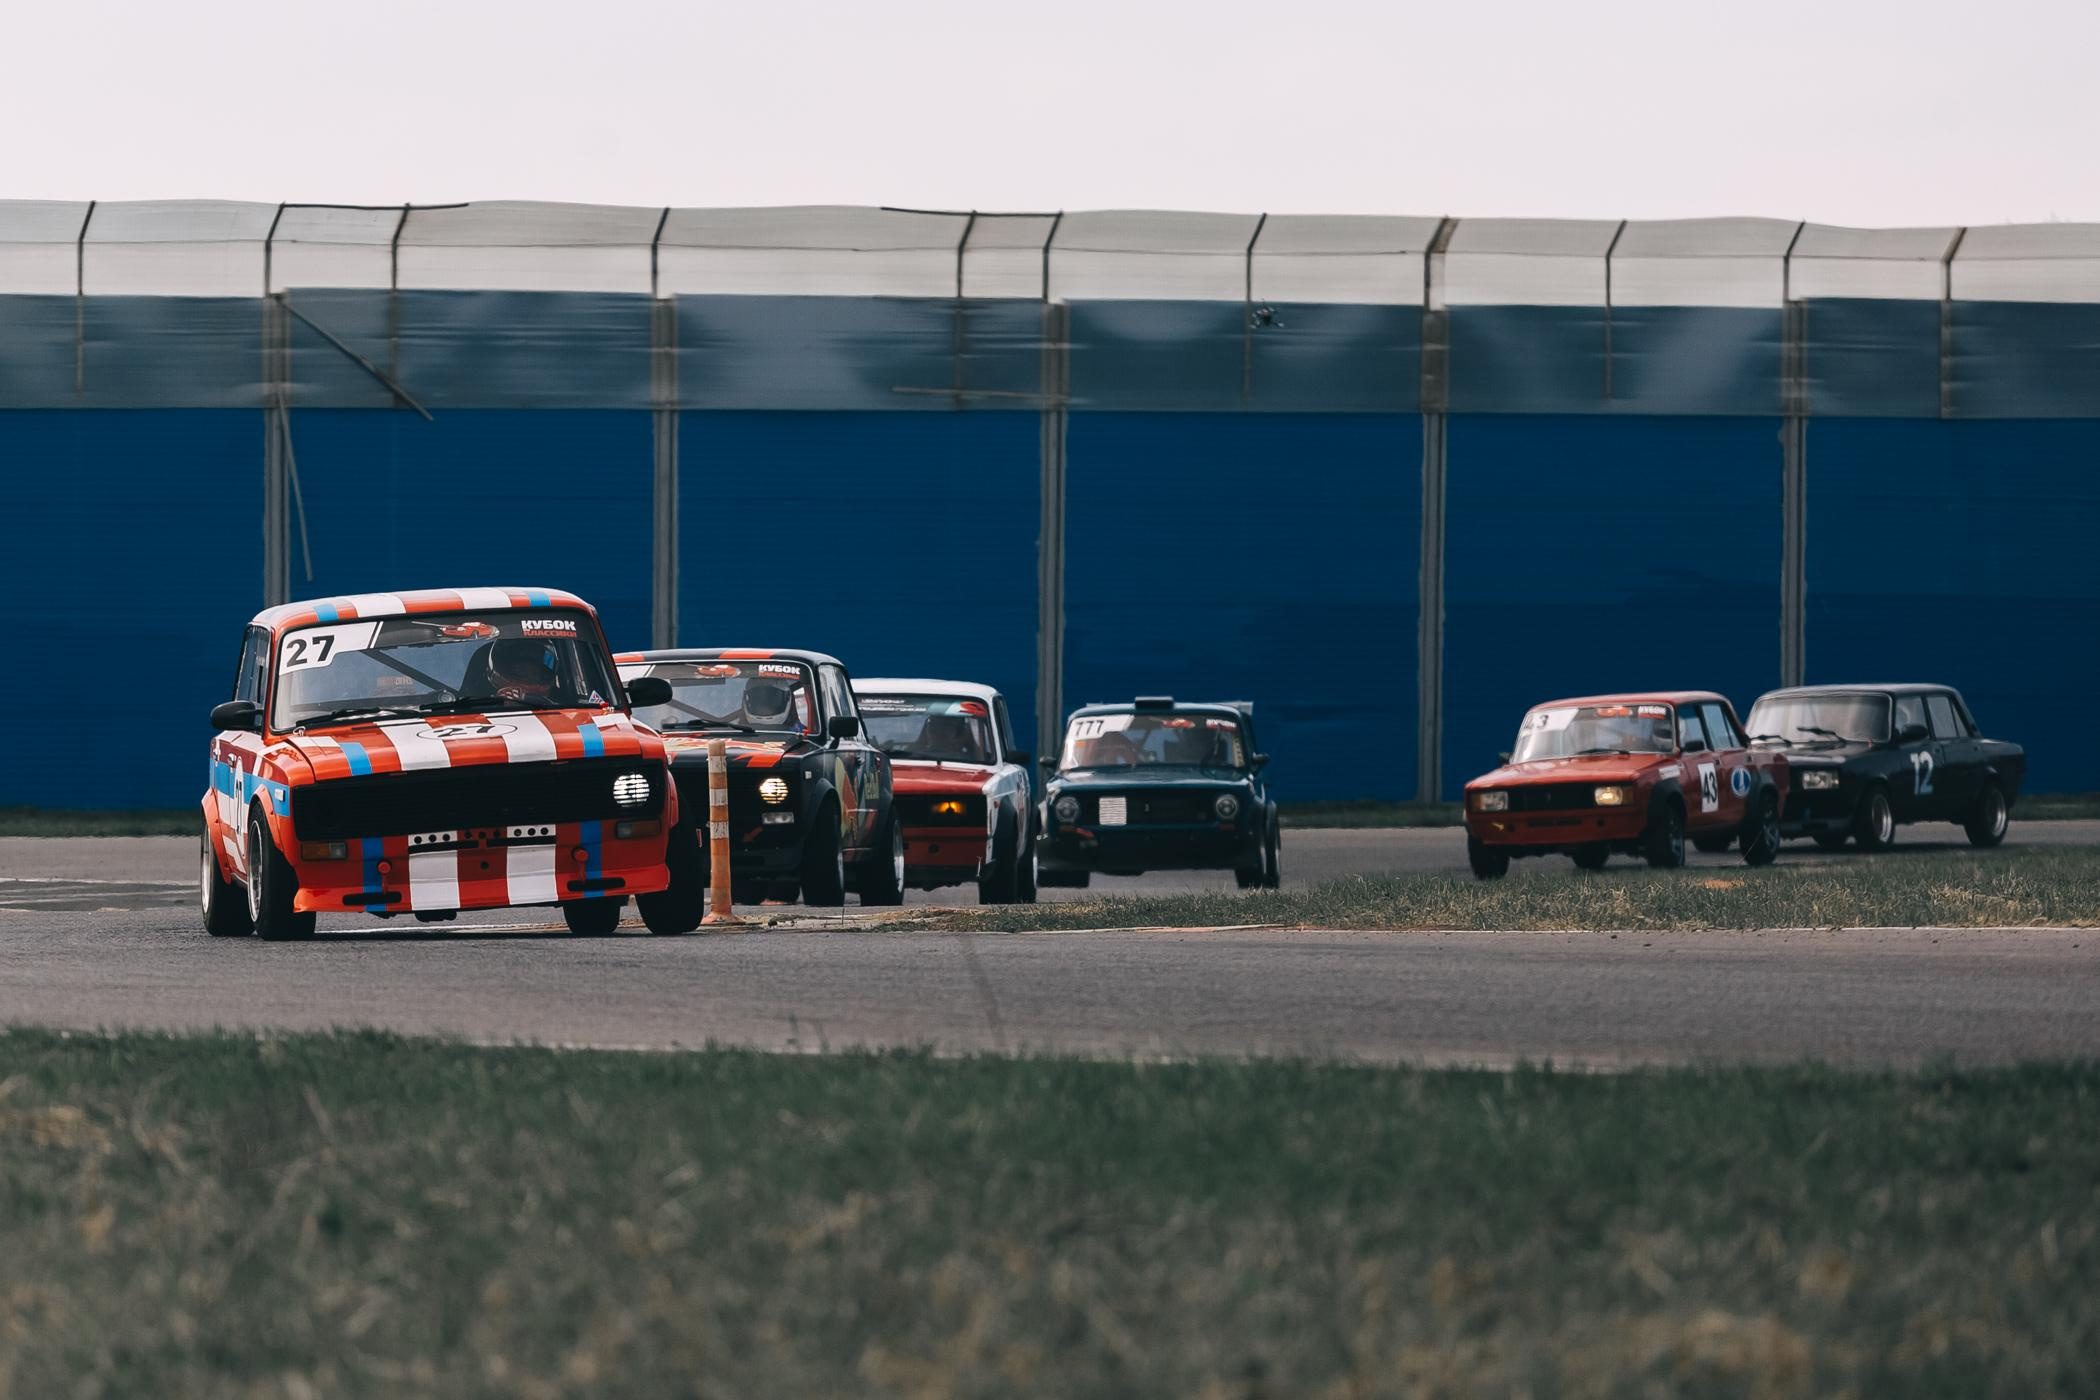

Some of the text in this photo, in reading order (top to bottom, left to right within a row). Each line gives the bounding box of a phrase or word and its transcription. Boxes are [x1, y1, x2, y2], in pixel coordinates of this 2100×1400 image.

[521, 620, 576, 631] КУБОК
[286, 634, 335, 668] 27
[758, 664, 801, 675] КУБОК
[433, 725, 496, 738] 27
[1076, 720, 1105, 736] 777
[1910, 751, 1934, 795] 12
[1703, 771, 1717, 804] 43
